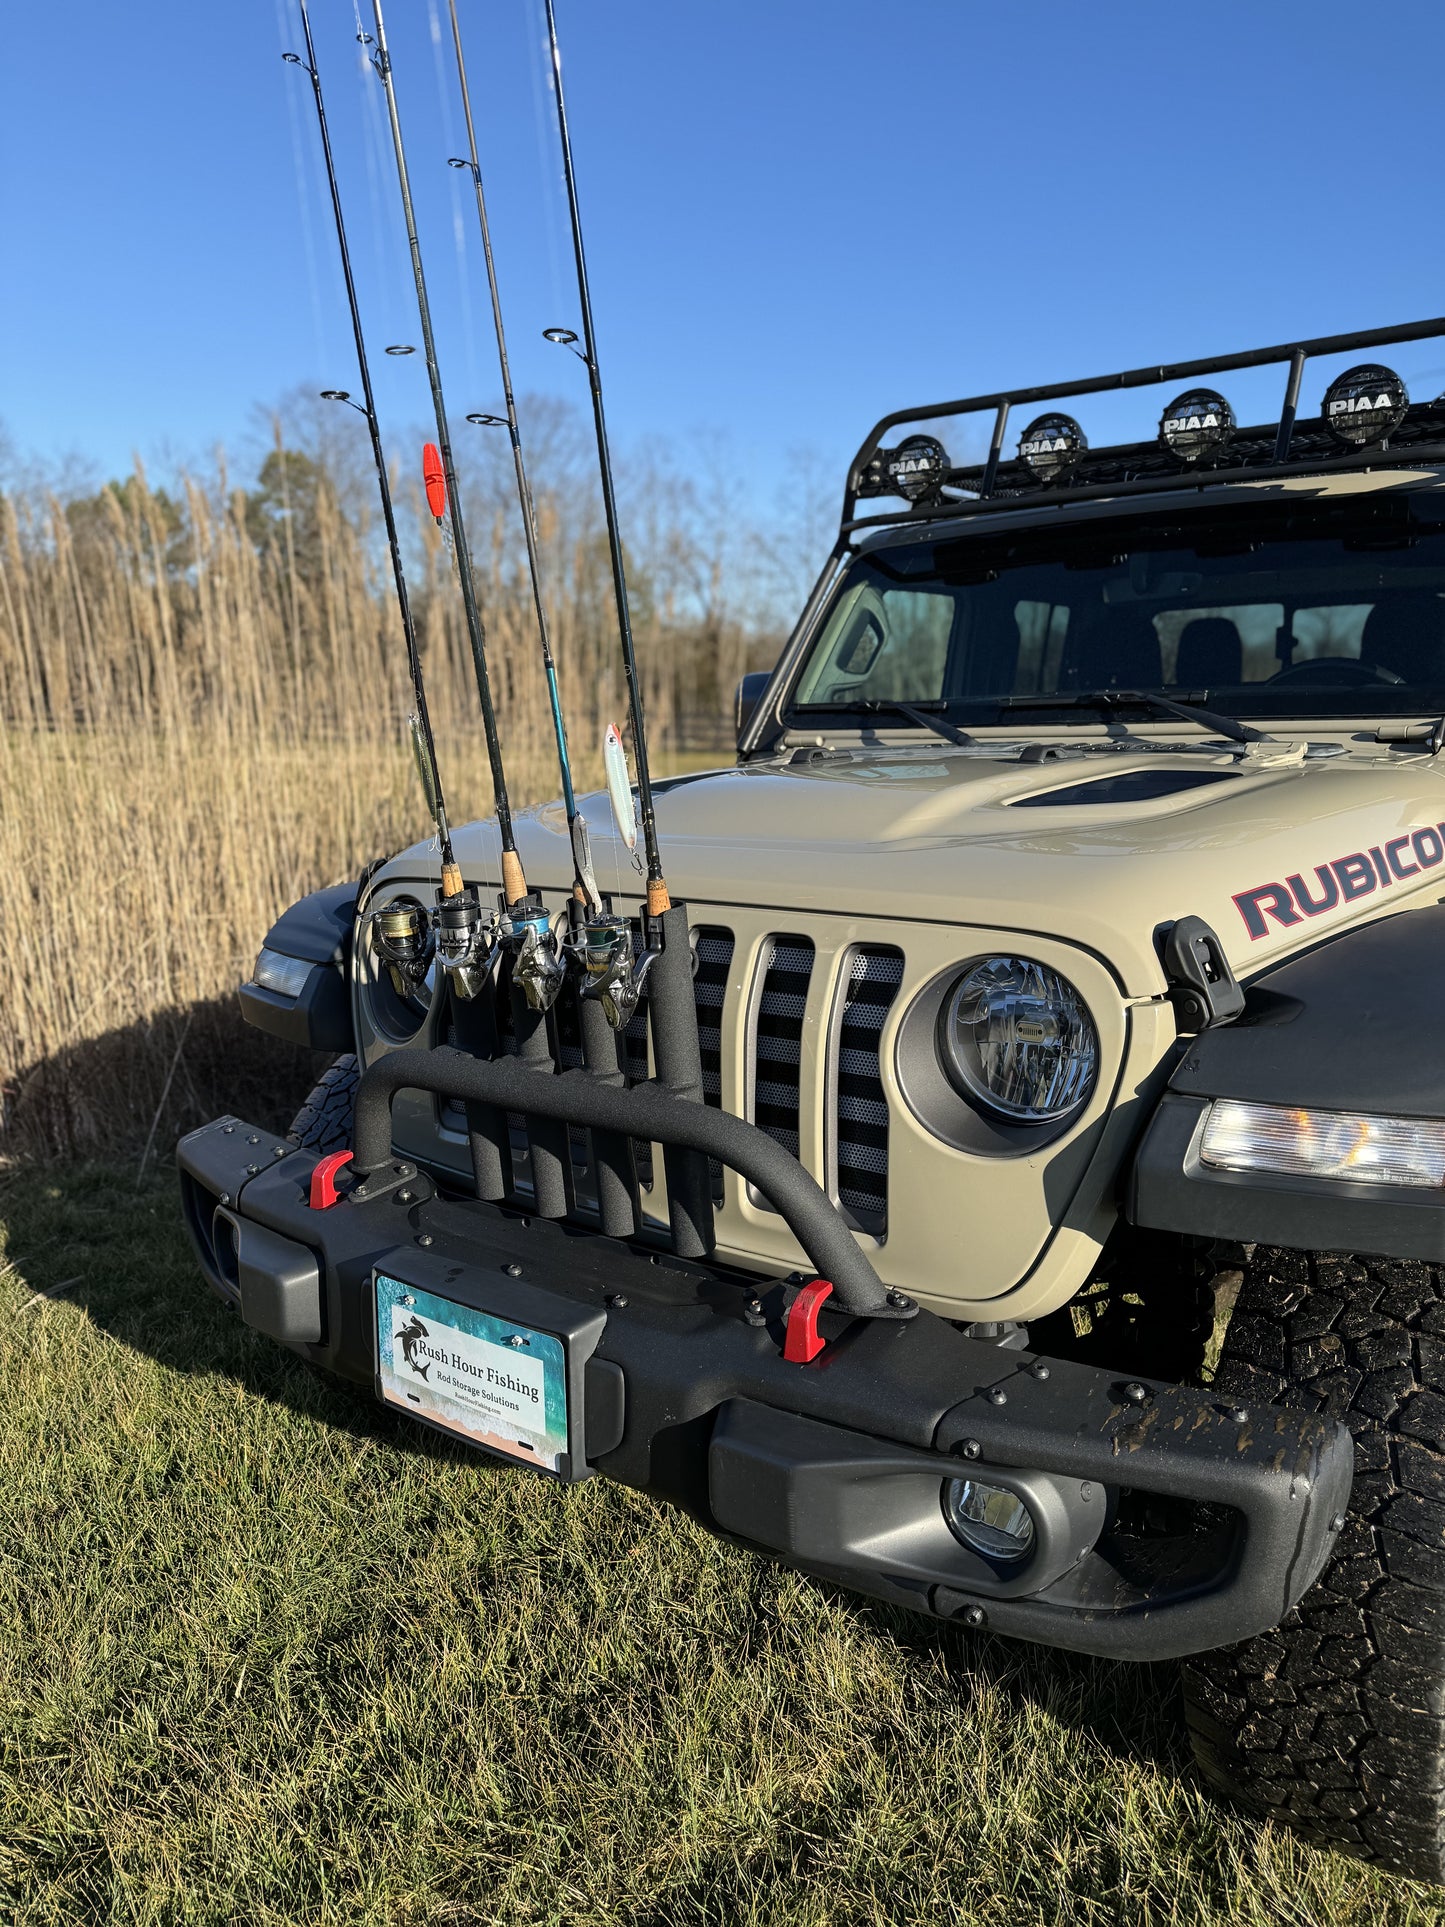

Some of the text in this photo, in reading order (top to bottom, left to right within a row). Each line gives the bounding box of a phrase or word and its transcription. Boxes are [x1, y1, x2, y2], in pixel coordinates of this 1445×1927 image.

[1329, 394, 1392, 416] PIAA
[1164, 414, 1218, 433] PIAA
[1021, 438, 1067, 455] PIAA
[889, 459, 930, 475] PIAA
[419, 1340, 539, 1403] Rush Hour Fishing
[437, 1370, 520, 1411] Rod Storage Solutions
